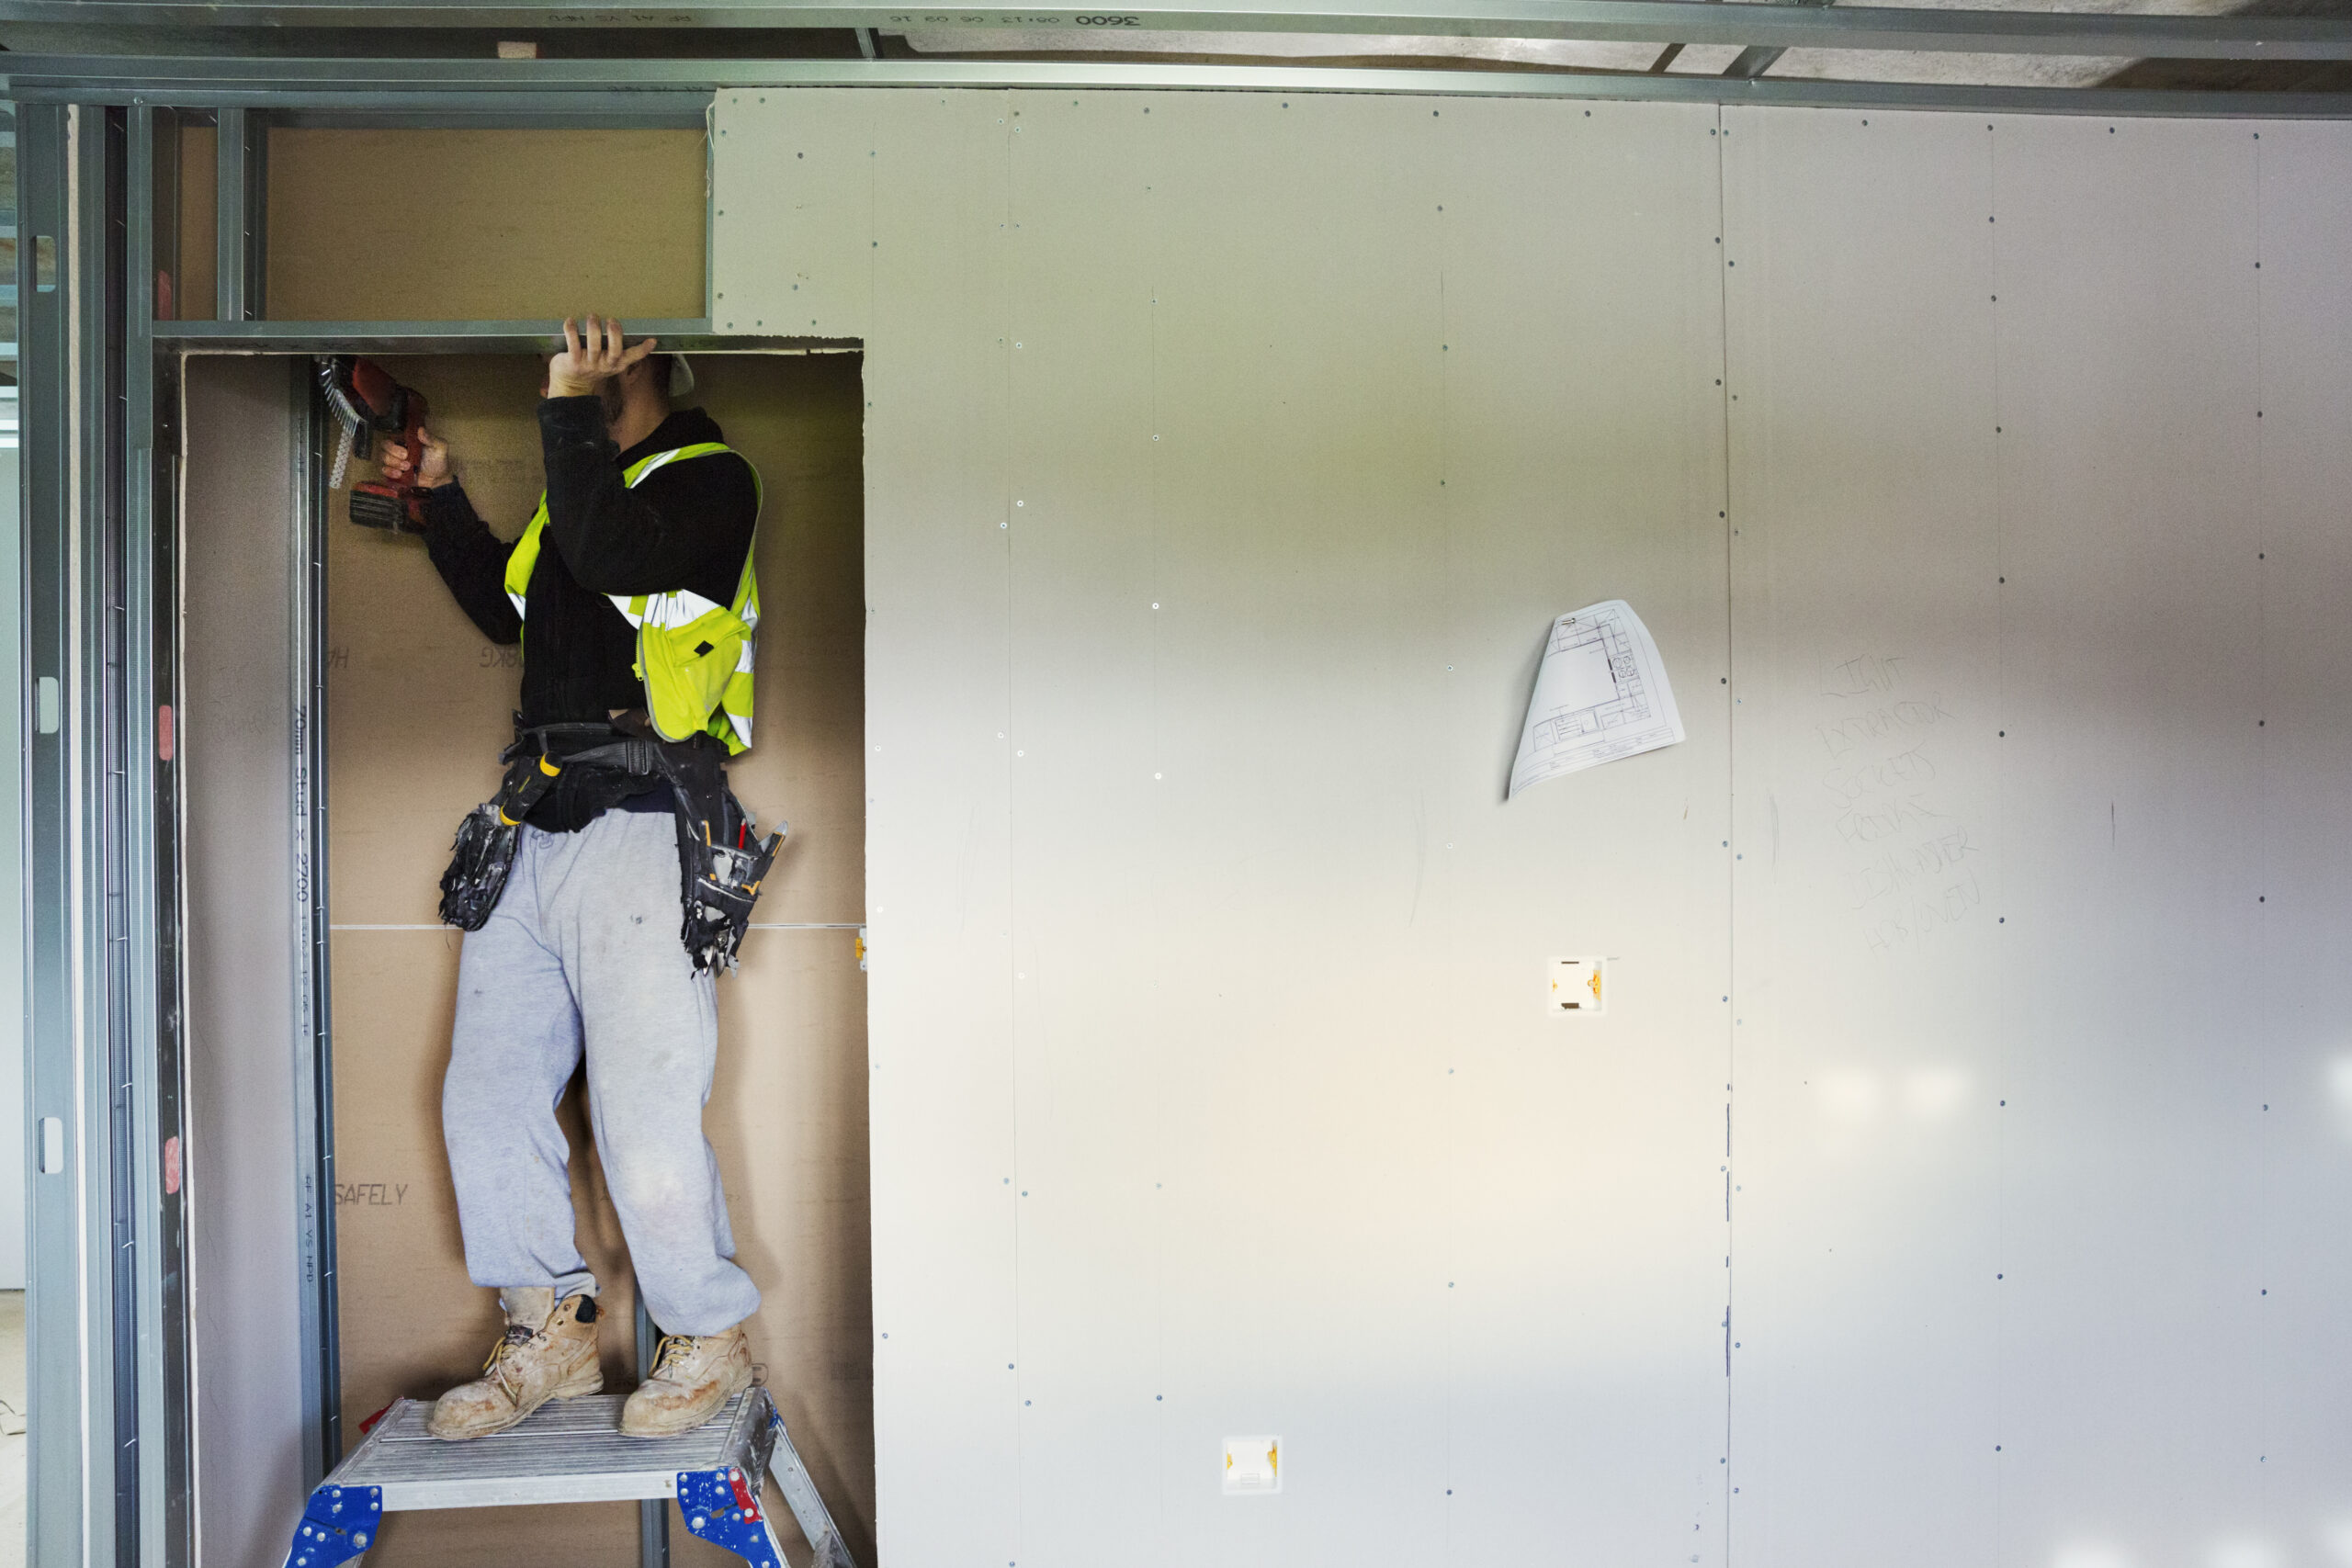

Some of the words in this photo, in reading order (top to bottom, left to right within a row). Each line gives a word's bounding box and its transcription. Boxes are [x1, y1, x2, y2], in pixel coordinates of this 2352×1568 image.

[1075, 16, 1141, 27] 3600
[294, 705, 308, 756] 70mm
[295, 766, 309, 818] Stud
[296, 852, 310, 903] 2700
[334, 1182, 409, 1206] SAFELY
